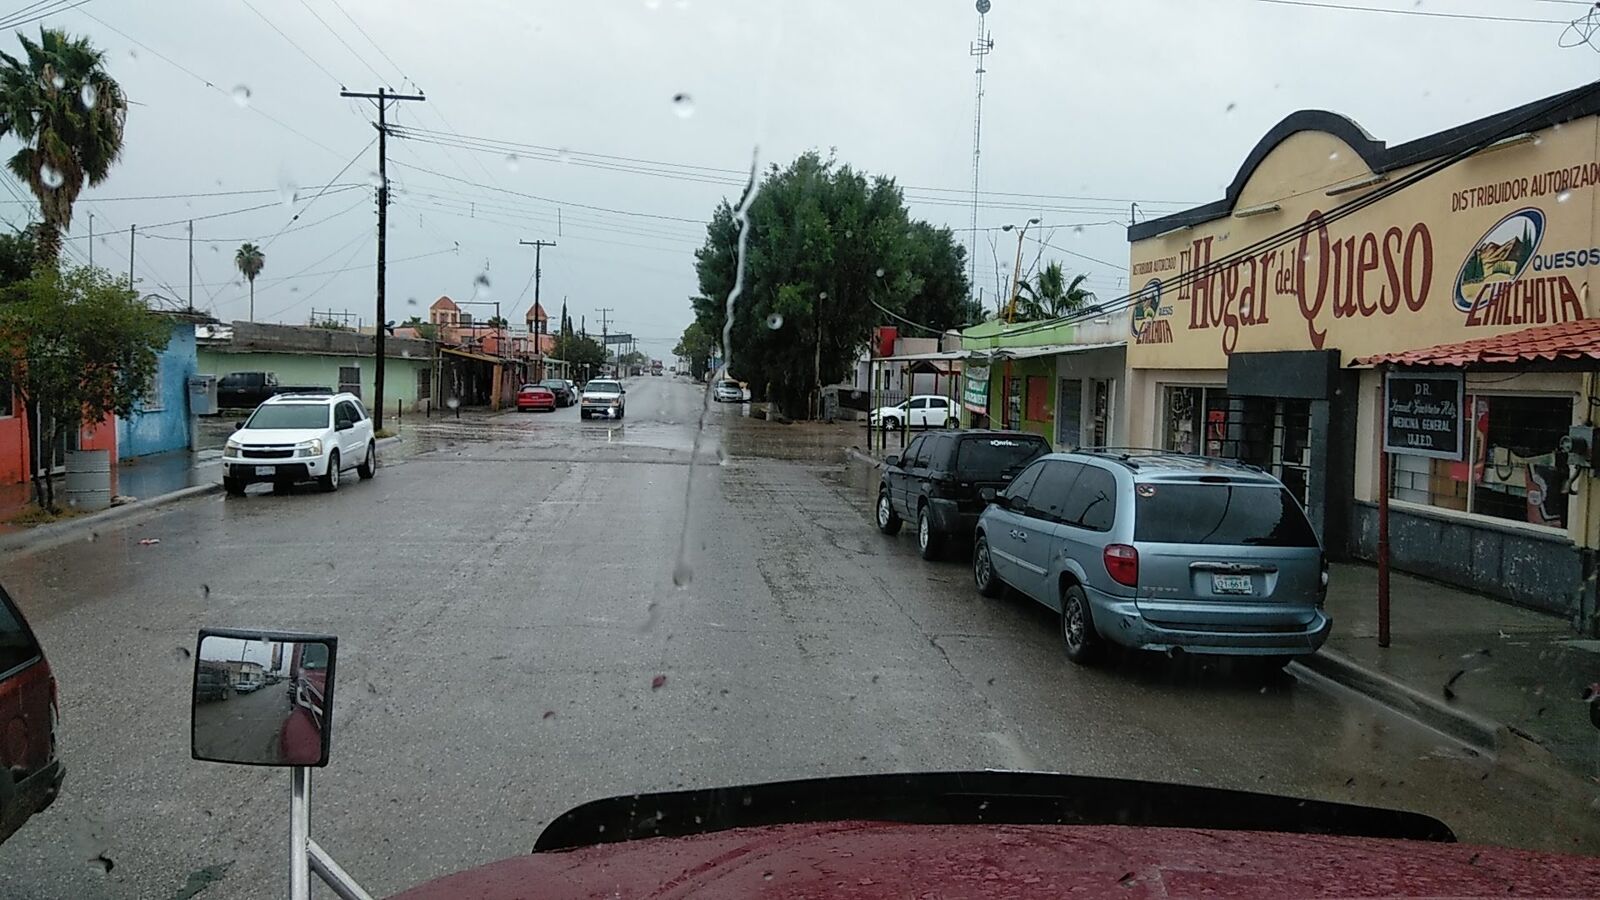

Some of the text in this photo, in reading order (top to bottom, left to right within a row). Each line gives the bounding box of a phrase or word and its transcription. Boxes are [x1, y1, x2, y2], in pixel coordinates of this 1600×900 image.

[1452, 162, 1600, 212] DISTRIBUIDOR AUTORIZAD
[1533, 248, 1600, 272] QUESOS
[1178, 209, 1433, 356] El Hogar del Queso
[1465, 275, 1584, 327] CHILCHOTA
[1414, 383, 1432, 395] DR.
[1392, 416, 1451, 432] MEDICINA GENERAL
